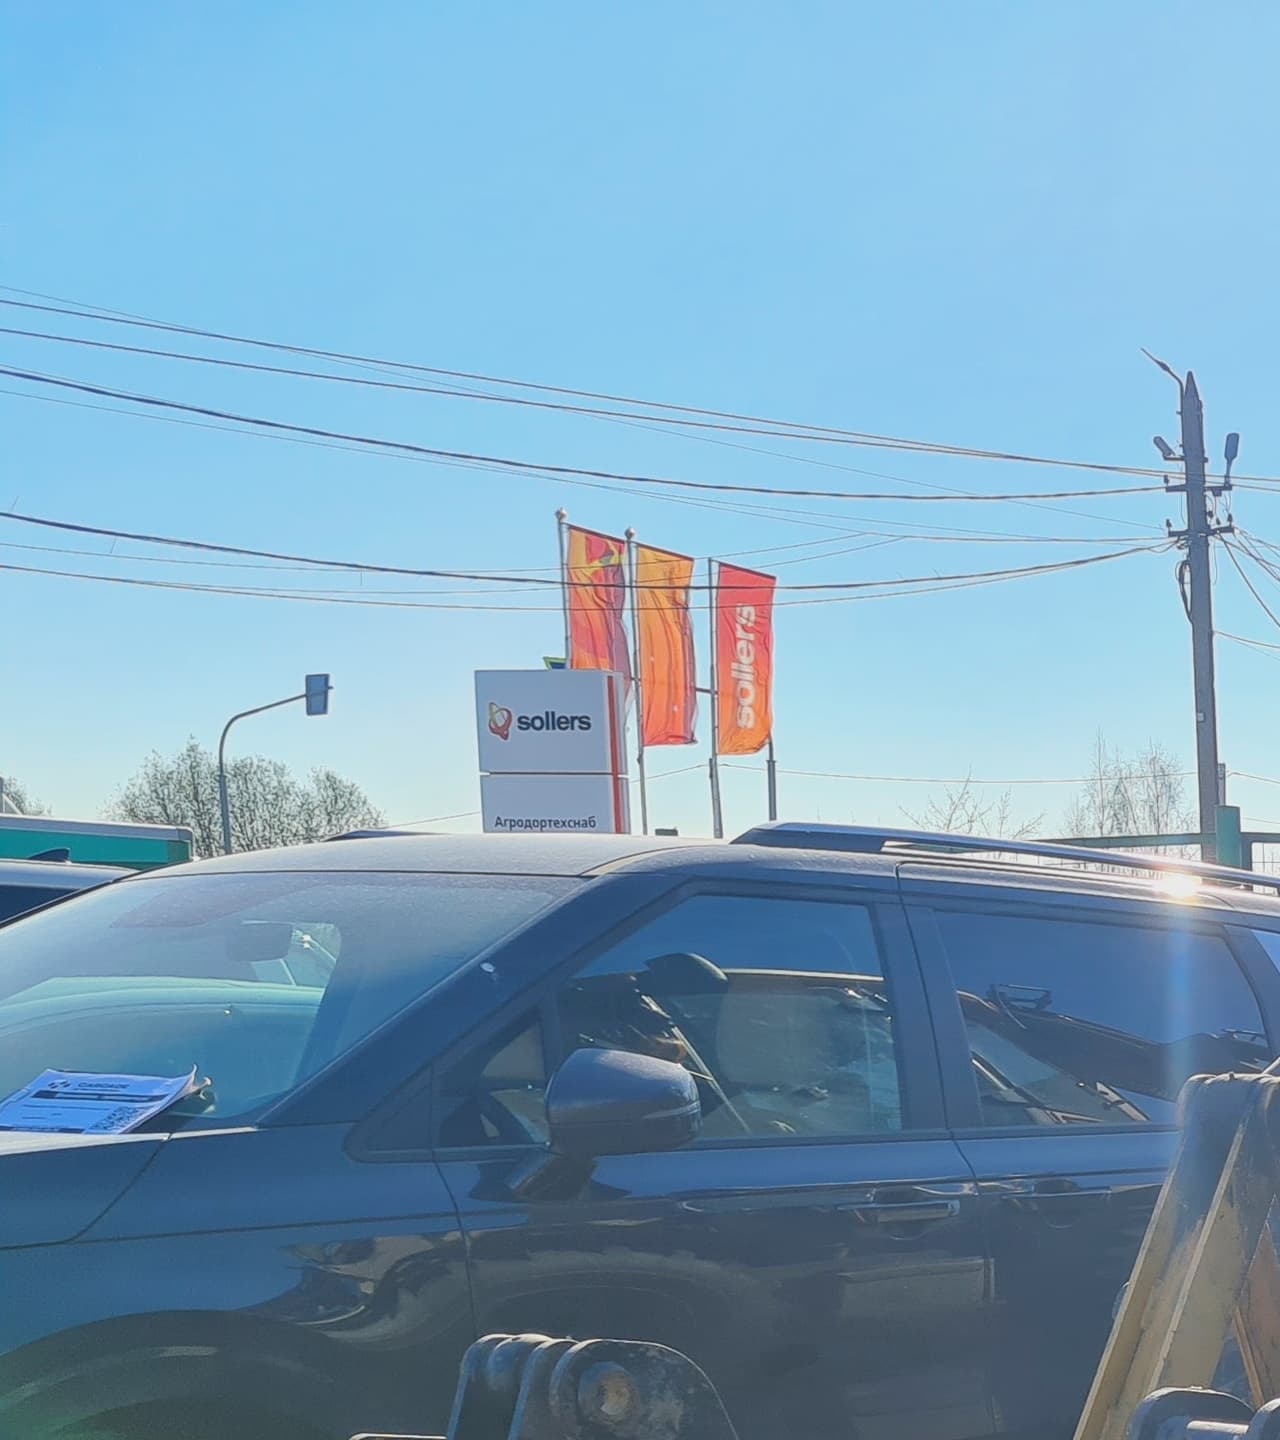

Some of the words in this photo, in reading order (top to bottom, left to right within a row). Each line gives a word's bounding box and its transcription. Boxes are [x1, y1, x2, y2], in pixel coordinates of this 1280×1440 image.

[731, 603, 756, 729] sollers
[517, 711, 592, 731] sollers
[494, 816, 597, 832] Агродортехснаб
